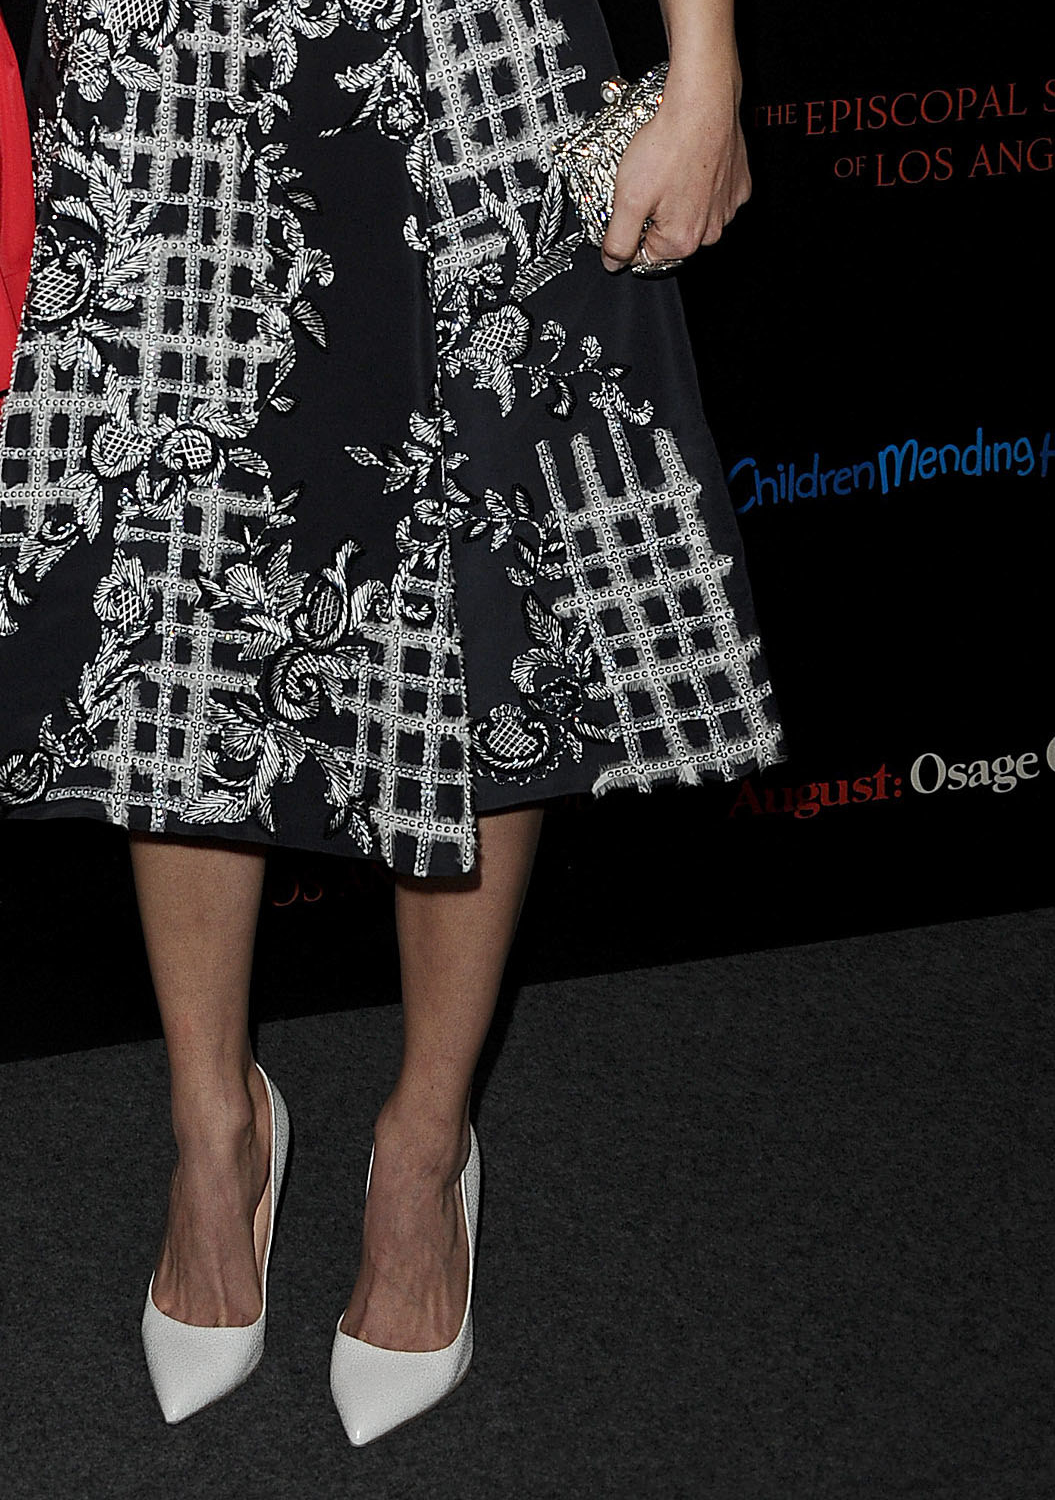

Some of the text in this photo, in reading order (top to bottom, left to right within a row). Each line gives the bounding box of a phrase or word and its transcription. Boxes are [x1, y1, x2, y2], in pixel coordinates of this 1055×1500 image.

[754, 101, 798, 129] THE
[804, 81, 1028, 136] EPISCOPAL
[833, 155, 868, 180] OF
[874, 147, 954, 187] LOS
[727, 762, 903, 820] August:
[909, 752, 1040, 794] Osage
